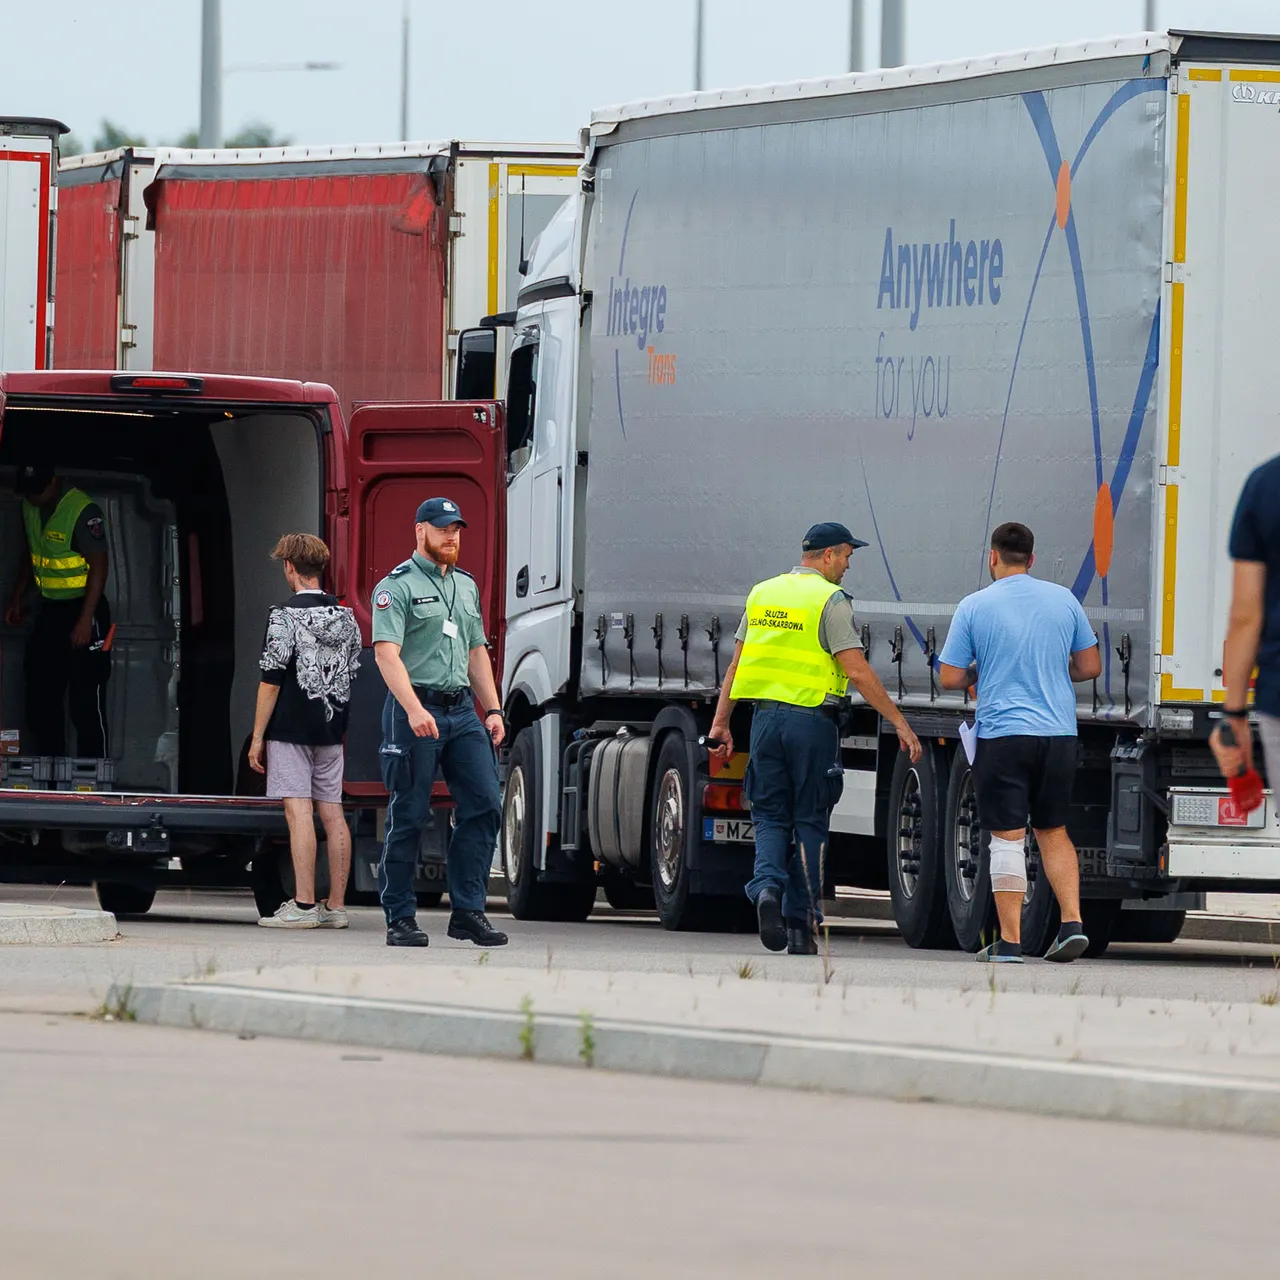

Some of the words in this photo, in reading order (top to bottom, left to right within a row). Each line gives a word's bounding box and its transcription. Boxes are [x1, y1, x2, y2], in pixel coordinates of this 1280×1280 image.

[877, 218, 1004, 331] Anywhere
[606, 276, 667, 351] Integre
[647, 345, 677, 387] Trans
[875, 331, 905, 419] for
[907, 355, 951, 441] you
[726, 821, 754, 840] MZ
